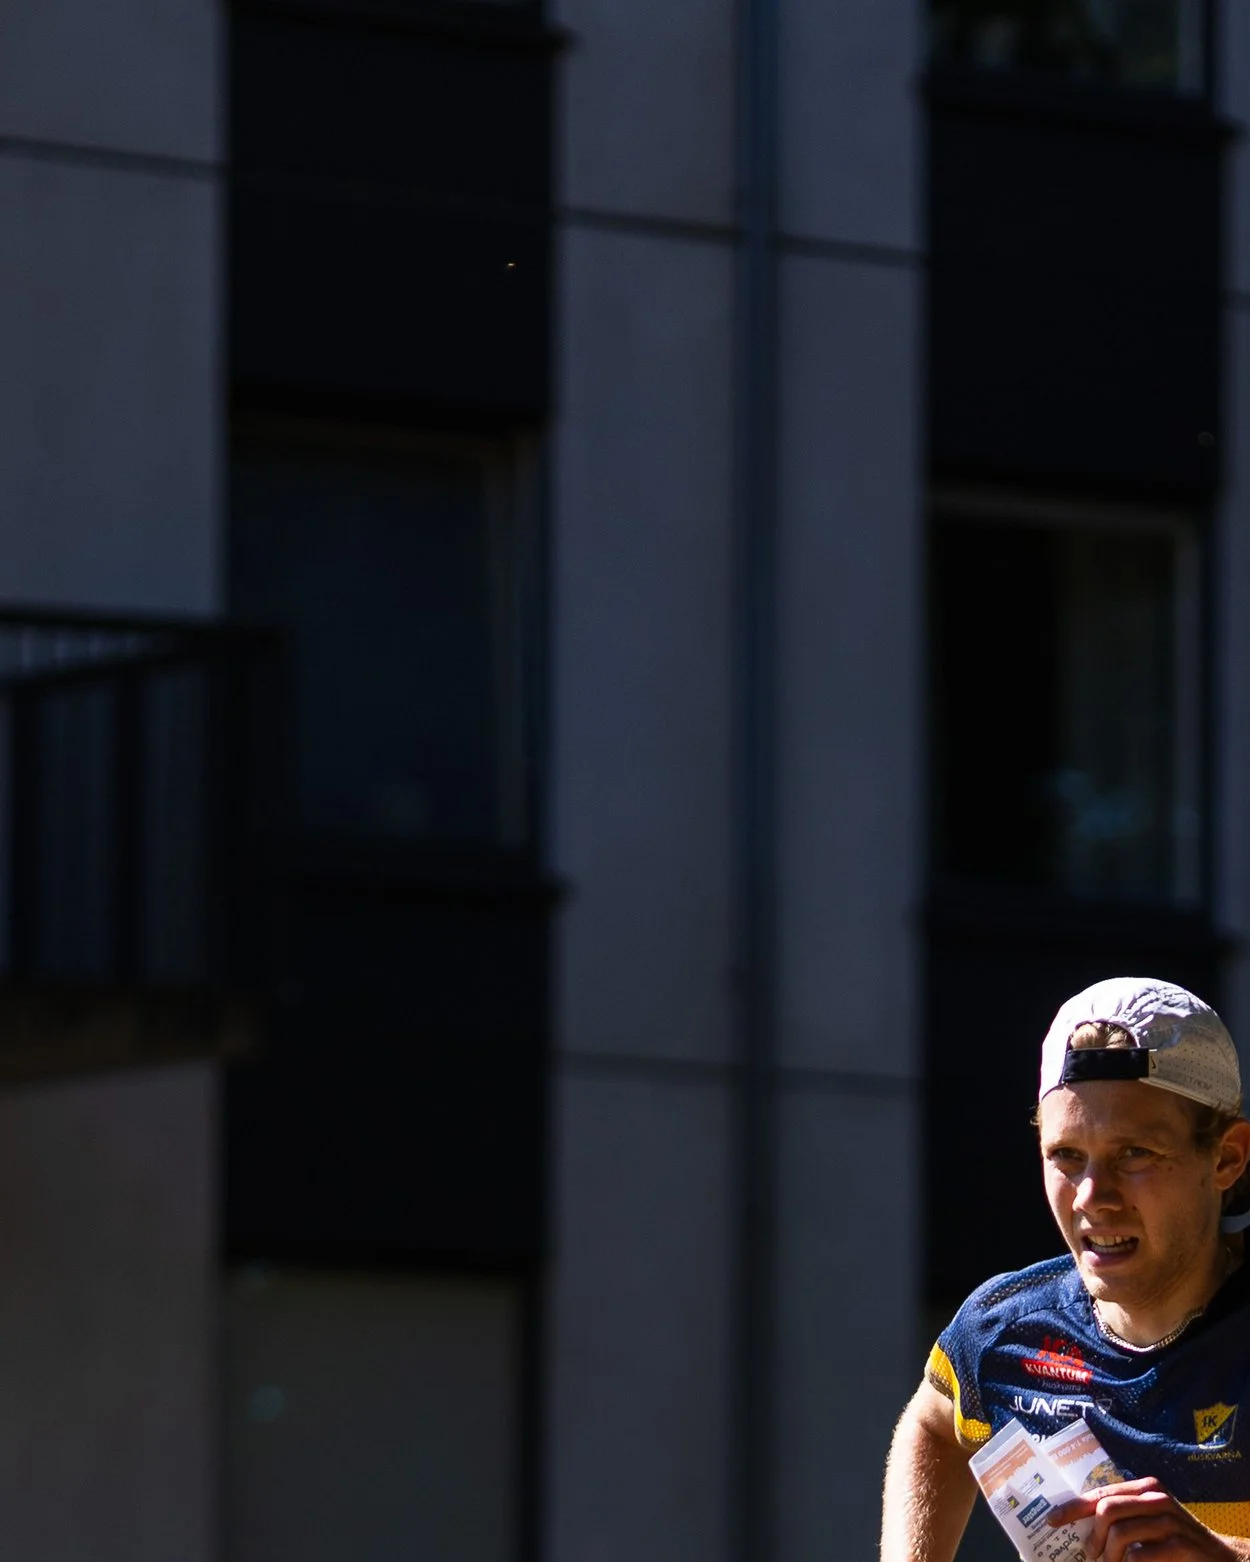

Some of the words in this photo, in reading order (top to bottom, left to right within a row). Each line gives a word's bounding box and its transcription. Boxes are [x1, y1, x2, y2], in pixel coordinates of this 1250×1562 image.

[1024, 1363, 1090, 1383] KVANTUM
[1203, 1414, 1218, 1428] IK
[1187, 1450, 1242, 1462] HUSKVARNA
[1047, 1531, 1081, 1562] Sydved
